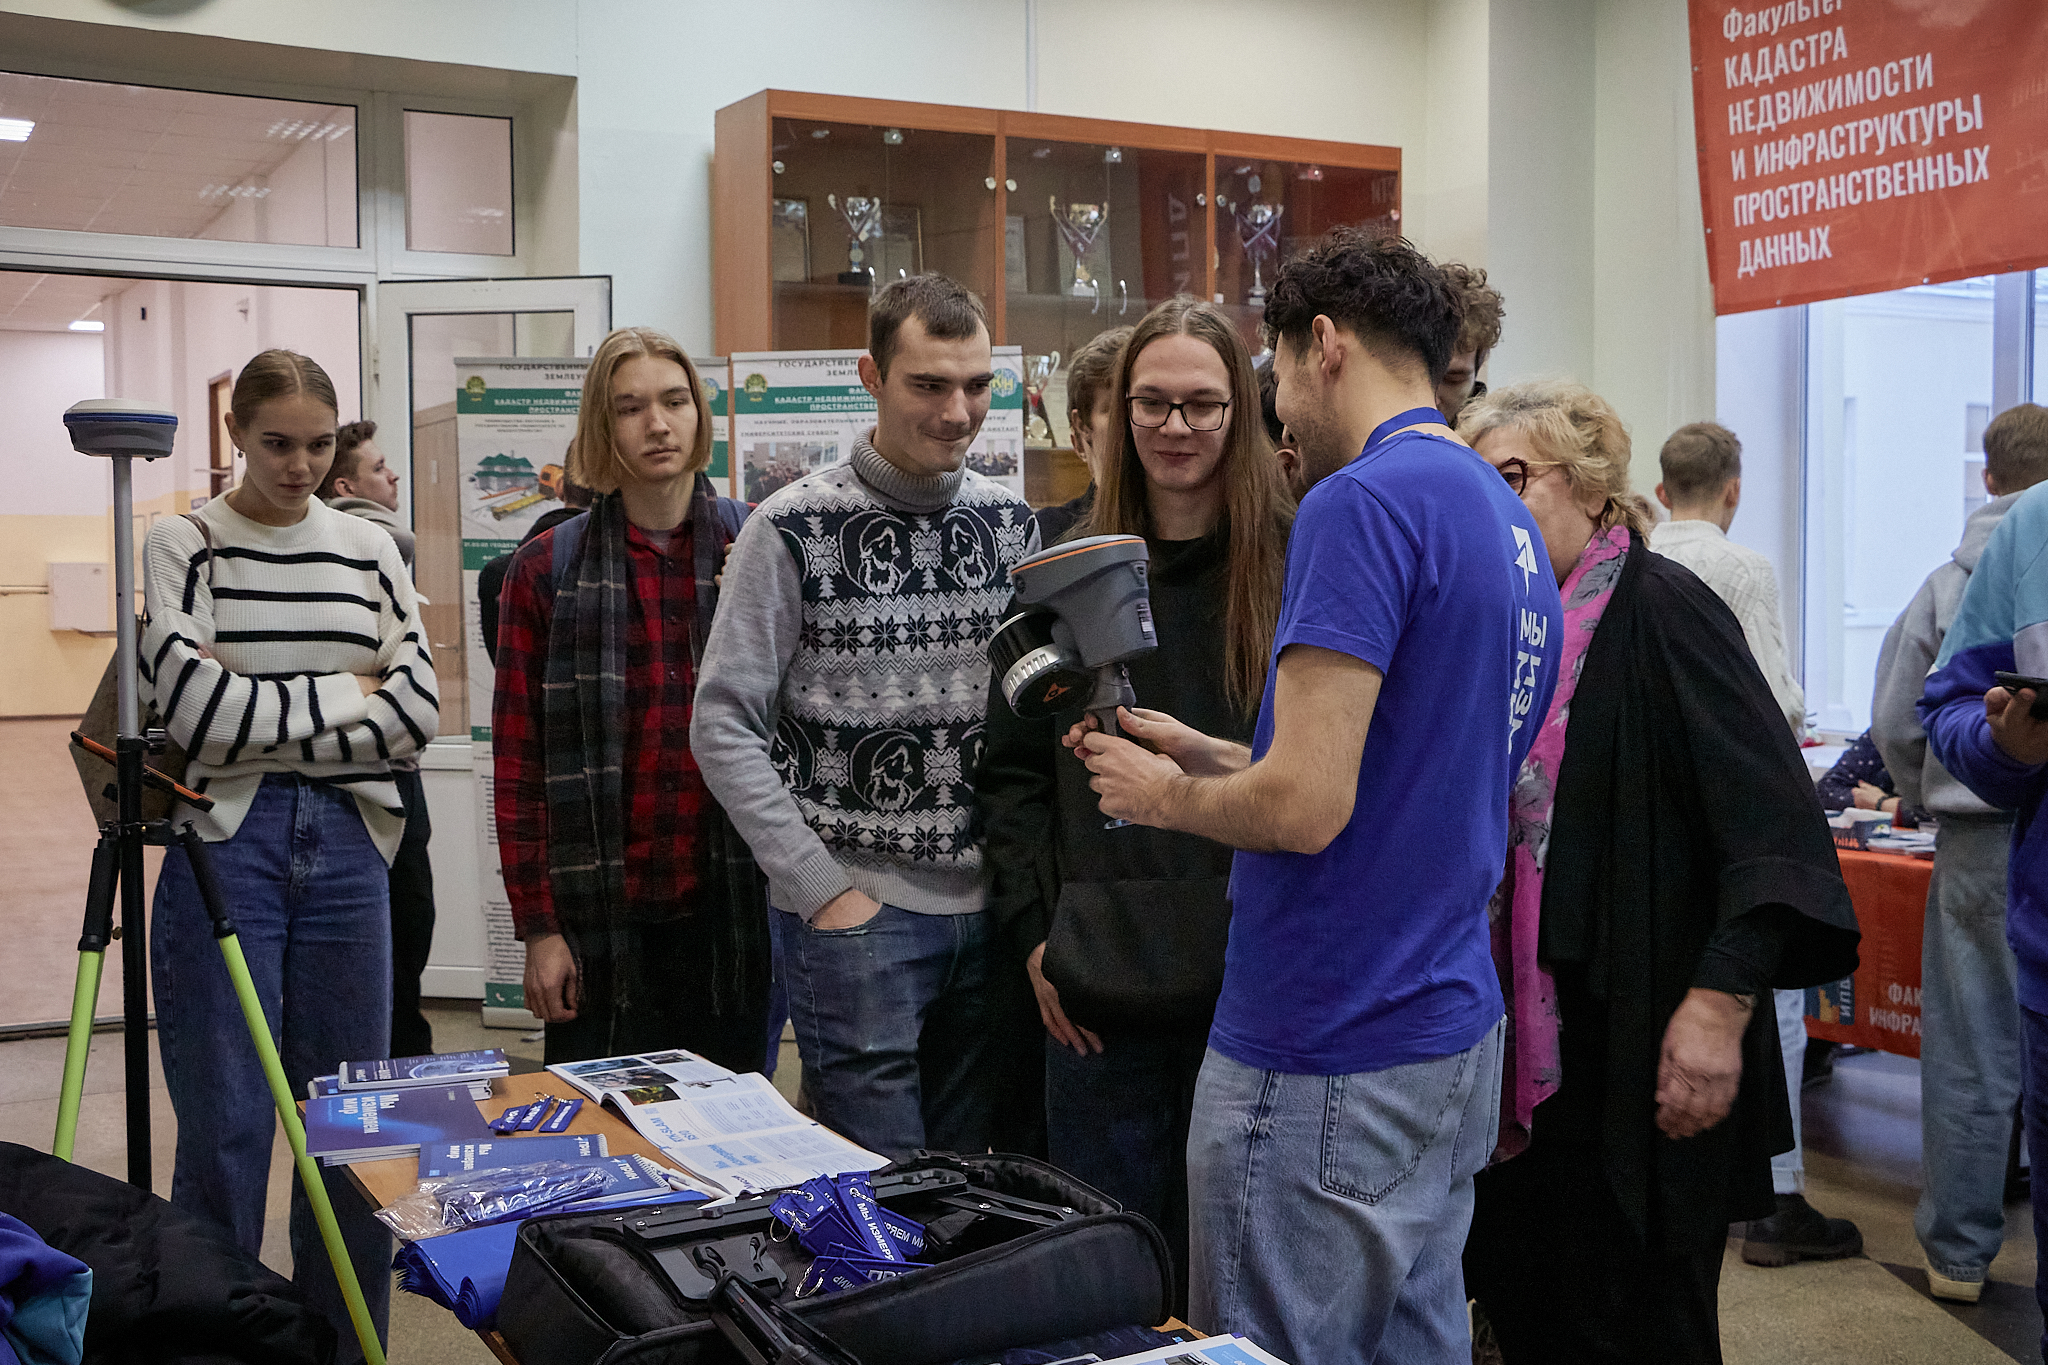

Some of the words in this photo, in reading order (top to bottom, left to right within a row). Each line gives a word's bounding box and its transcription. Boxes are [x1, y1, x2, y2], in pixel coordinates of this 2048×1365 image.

[1724, 26, 1848, 89] КАДАСТРА
[1728, 53, 1933, 135] НЕДВИЖИМОСТИ
[1731, 149, 1746, 182] И
[1753, 94, 1984, 177] ИНФРАСТРУКТУРЫ
[1733, 145, 1990, 227] ПРОСТРАНСТВЕННЫХ
[1737, 226, 1832, 279] ДАННЫХ
[1520, 608, 1547, 648] МЫ
[857, 1203, 872, 1221] МЫ
